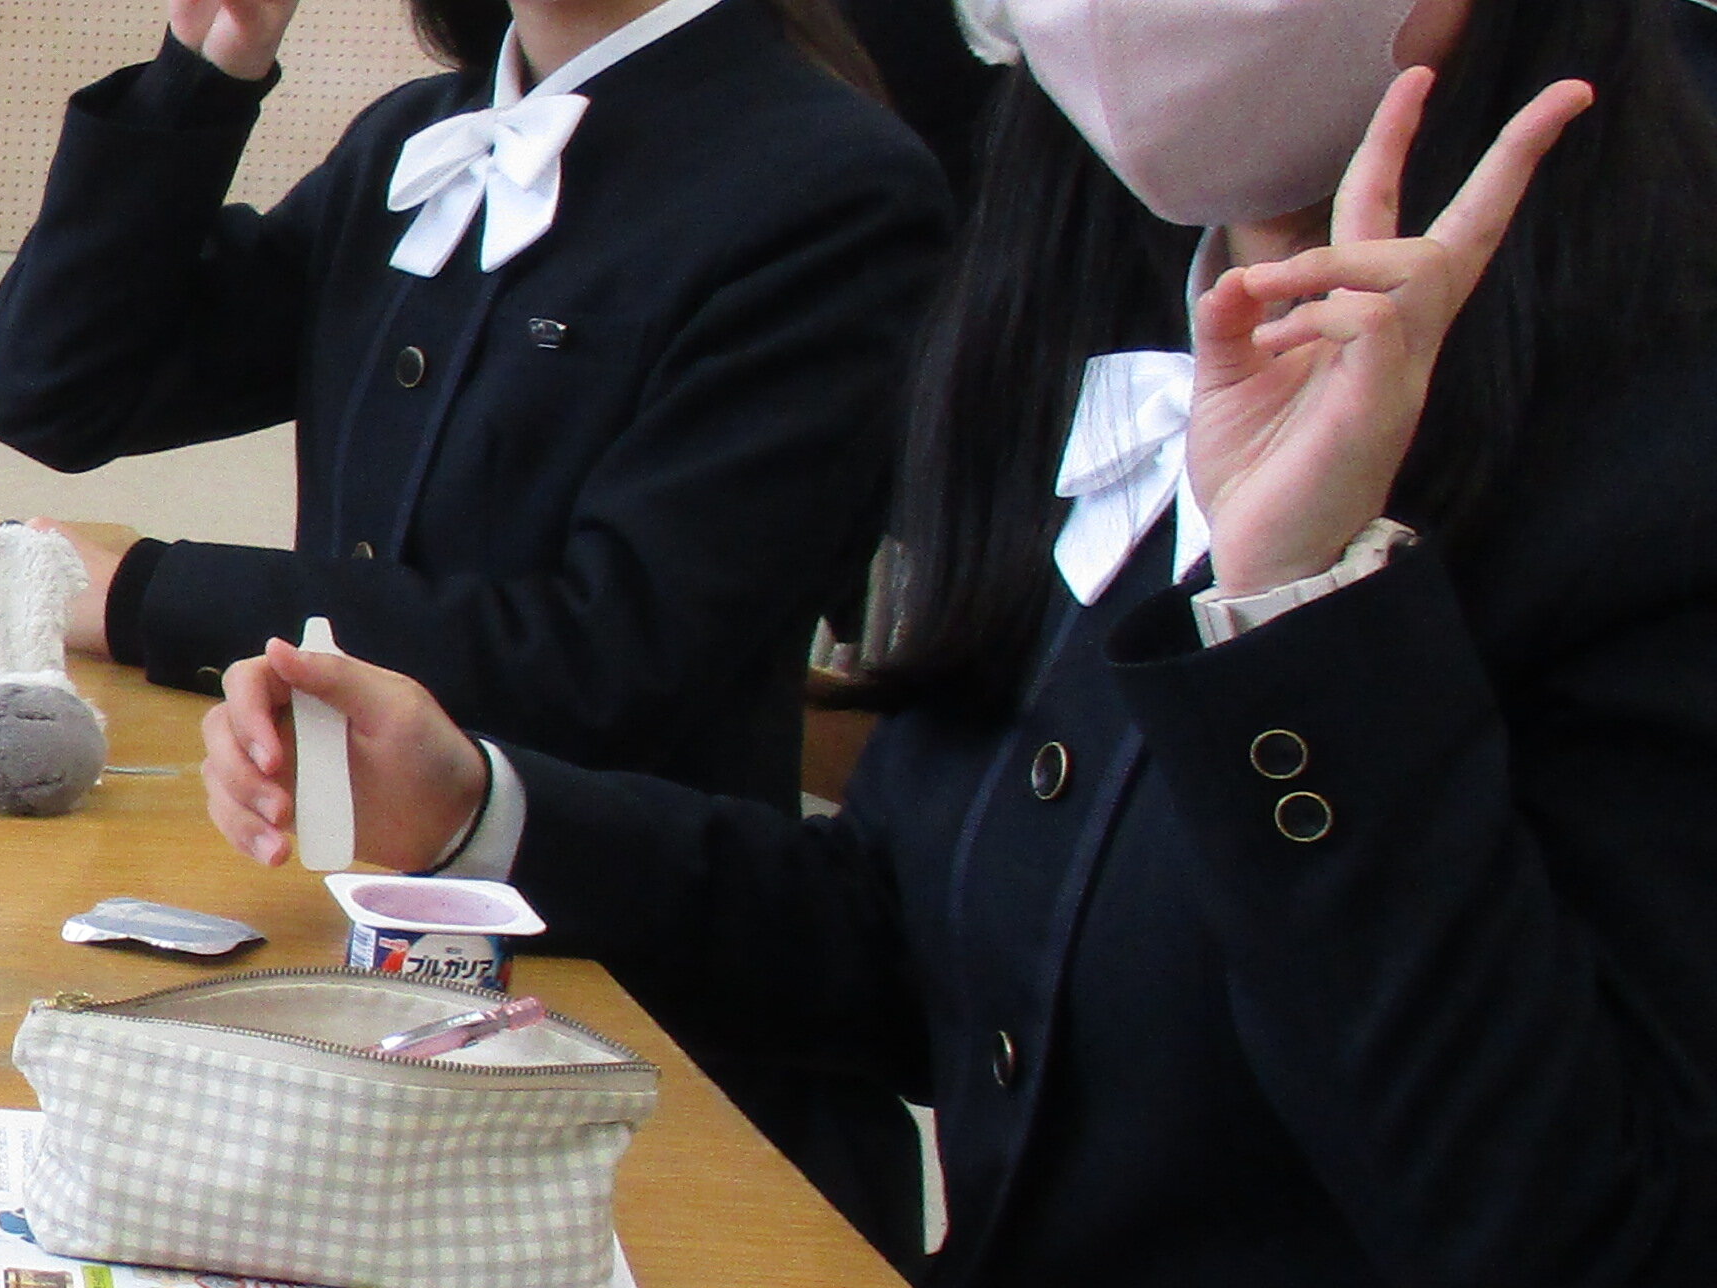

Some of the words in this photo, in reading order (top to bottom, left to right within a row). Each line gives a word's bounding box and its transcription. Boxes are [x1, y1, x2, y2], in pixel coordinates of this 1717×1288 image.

[407, 955, 494, 979] ブルガリア
